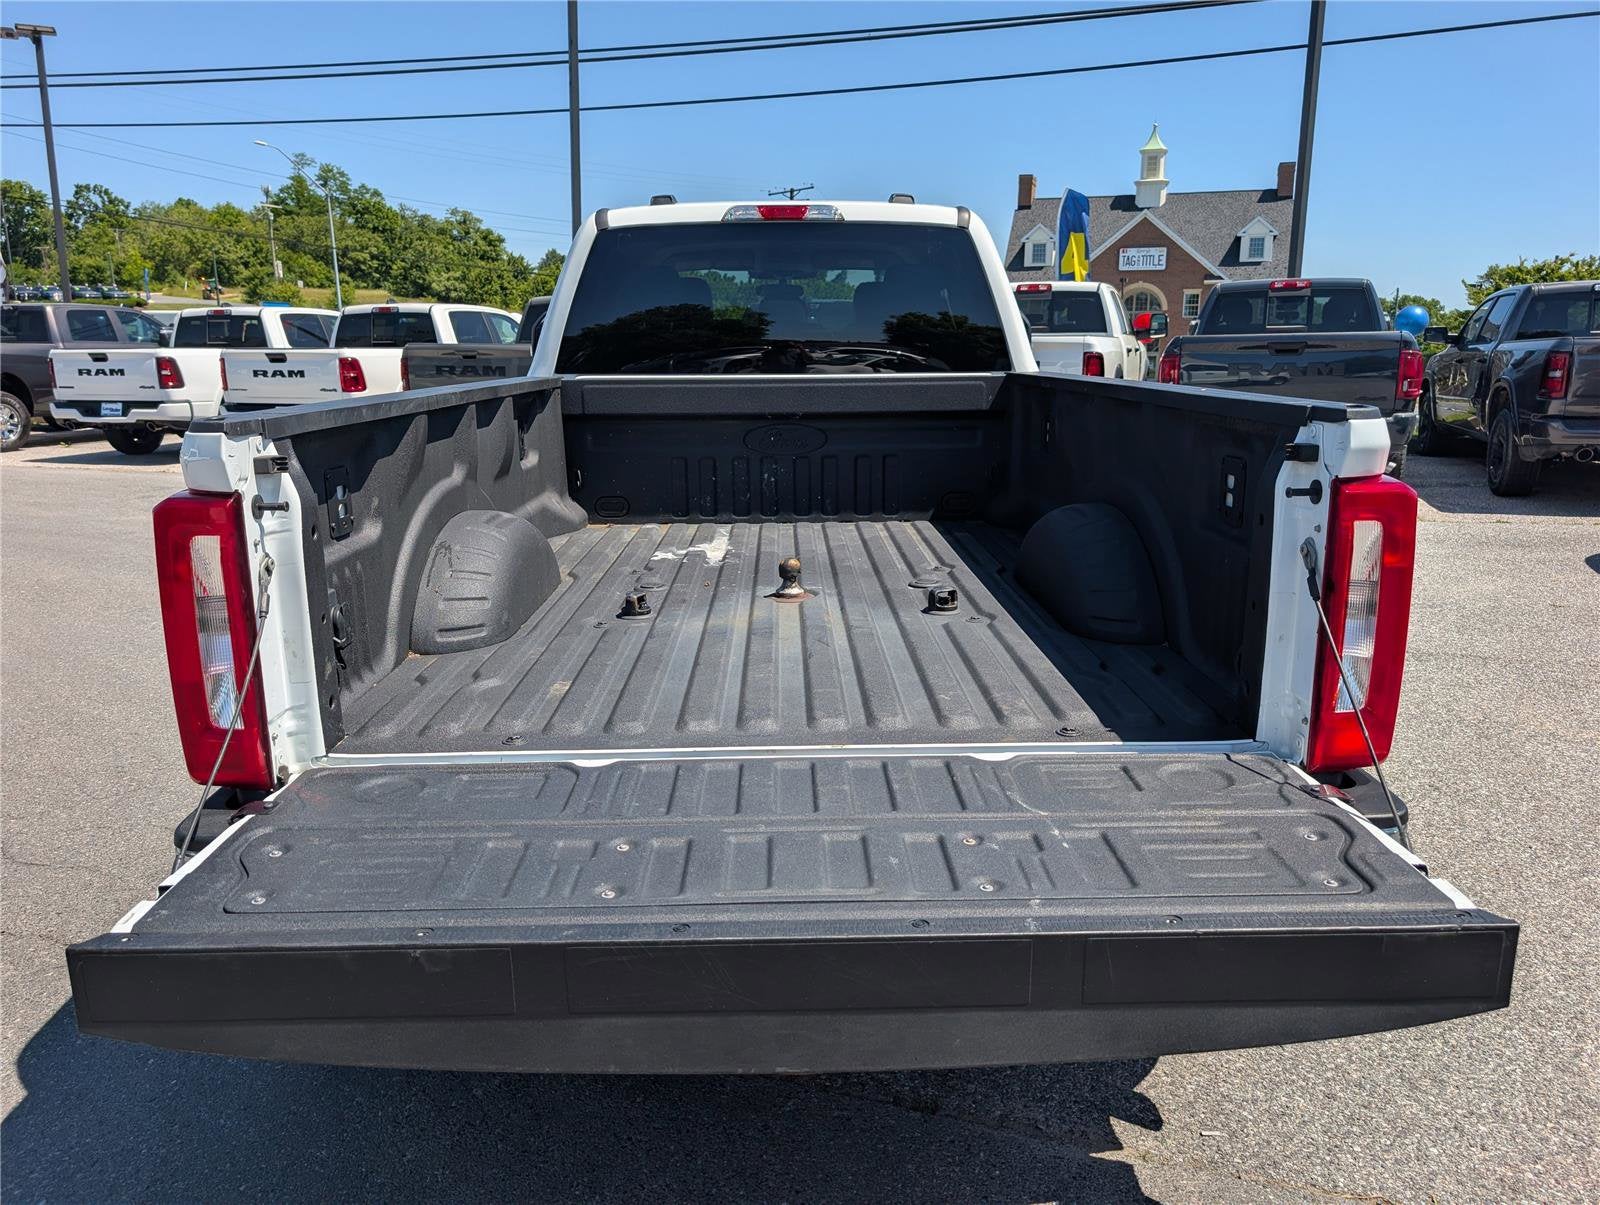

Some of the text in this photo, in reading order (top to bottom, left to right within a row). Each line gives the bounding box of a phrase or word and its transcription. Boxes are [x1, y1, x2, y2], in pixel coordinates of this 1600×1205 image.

[1121, 254, 1136, 267] TAG
[1141, 254, 1164, 267] TITLE
[77, 368, 126, 377] RAM
[252, 369, 306, 378] RAM
[435, 365, 506, 377] RAM
